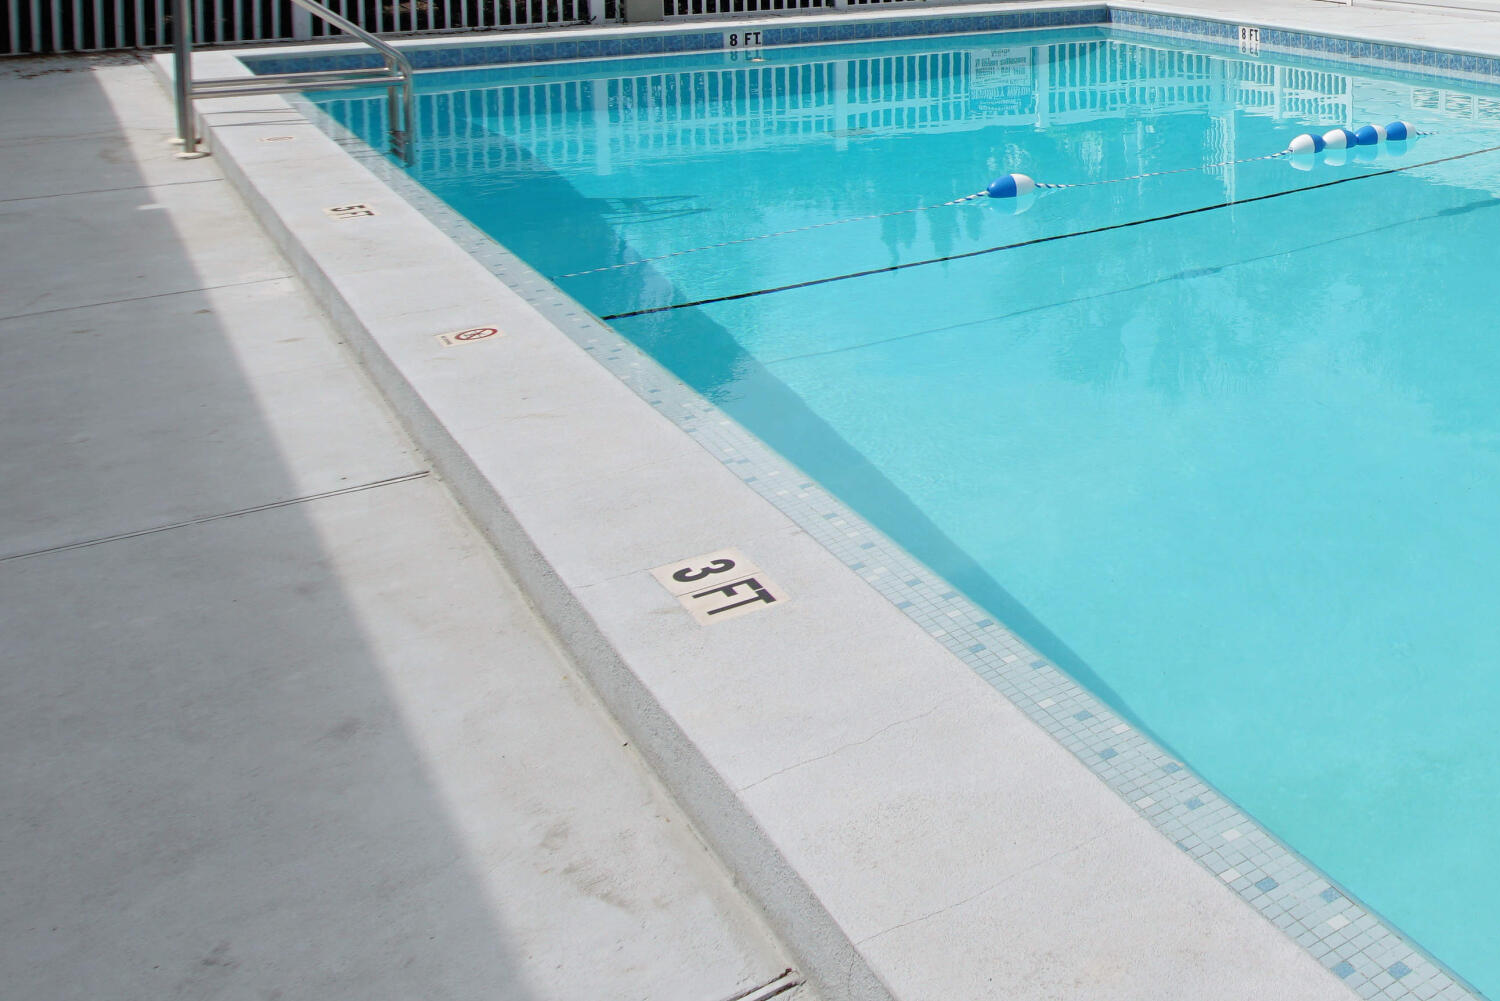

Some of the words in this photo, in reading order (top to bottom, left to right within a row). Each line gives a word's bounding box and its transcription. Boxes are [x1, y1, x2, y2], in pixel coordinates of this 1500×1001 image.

[729, 33, 738, 47] 8
[1241, 28, 1247, 40] 8
[672, 558, 736, 583] 3
[692, 577, 777, 616] FT
